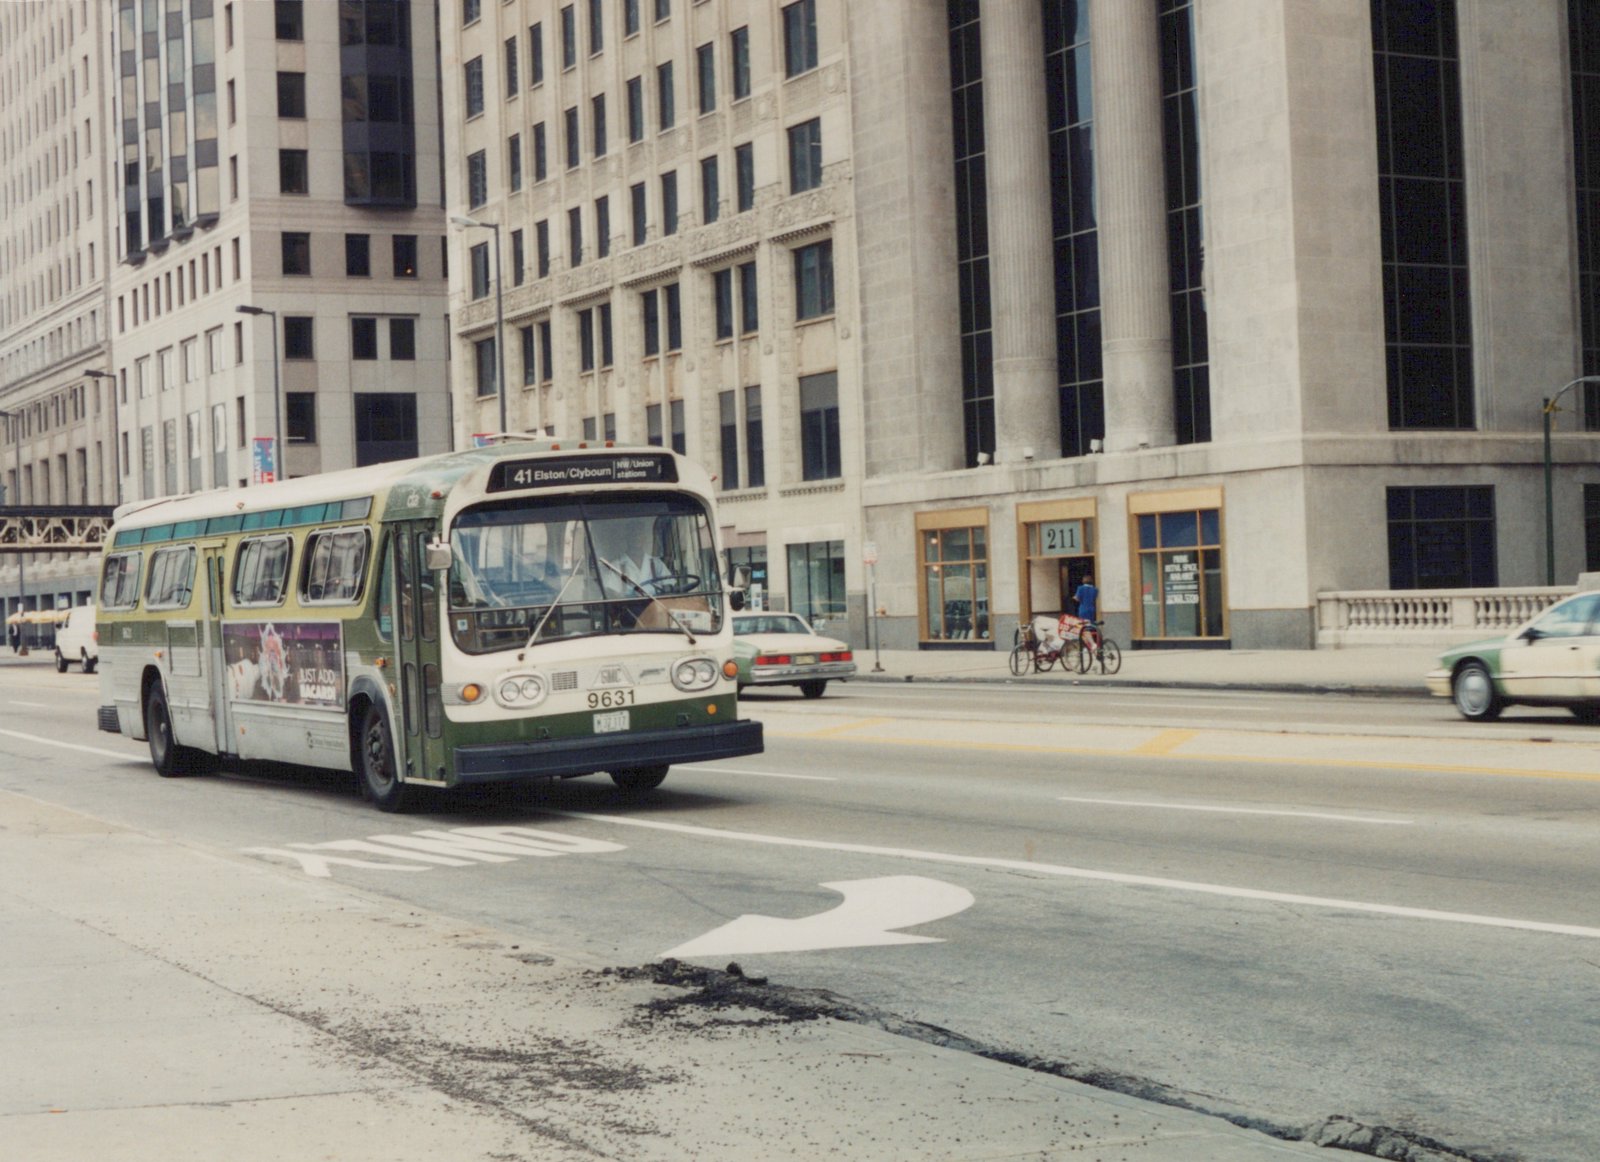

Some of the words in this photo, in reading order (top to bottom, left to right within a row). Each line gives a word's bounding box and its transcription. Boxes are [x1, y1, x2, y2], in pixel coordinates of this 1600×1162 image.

[513, 468, 533, 484] 41
[534, 466, 612, 480] Elston/Clybourn
[616, 470, 647, 479] stations
[1047, 527, 1076, 549] 211
[299, 668, 316, 682] JUST
[318, 669, 335, 684] ADD
[300, 684, 336, 700] BACARDI
[587, 688, 635, 709] 9631
[235, 826, 629, 878] ONLY
